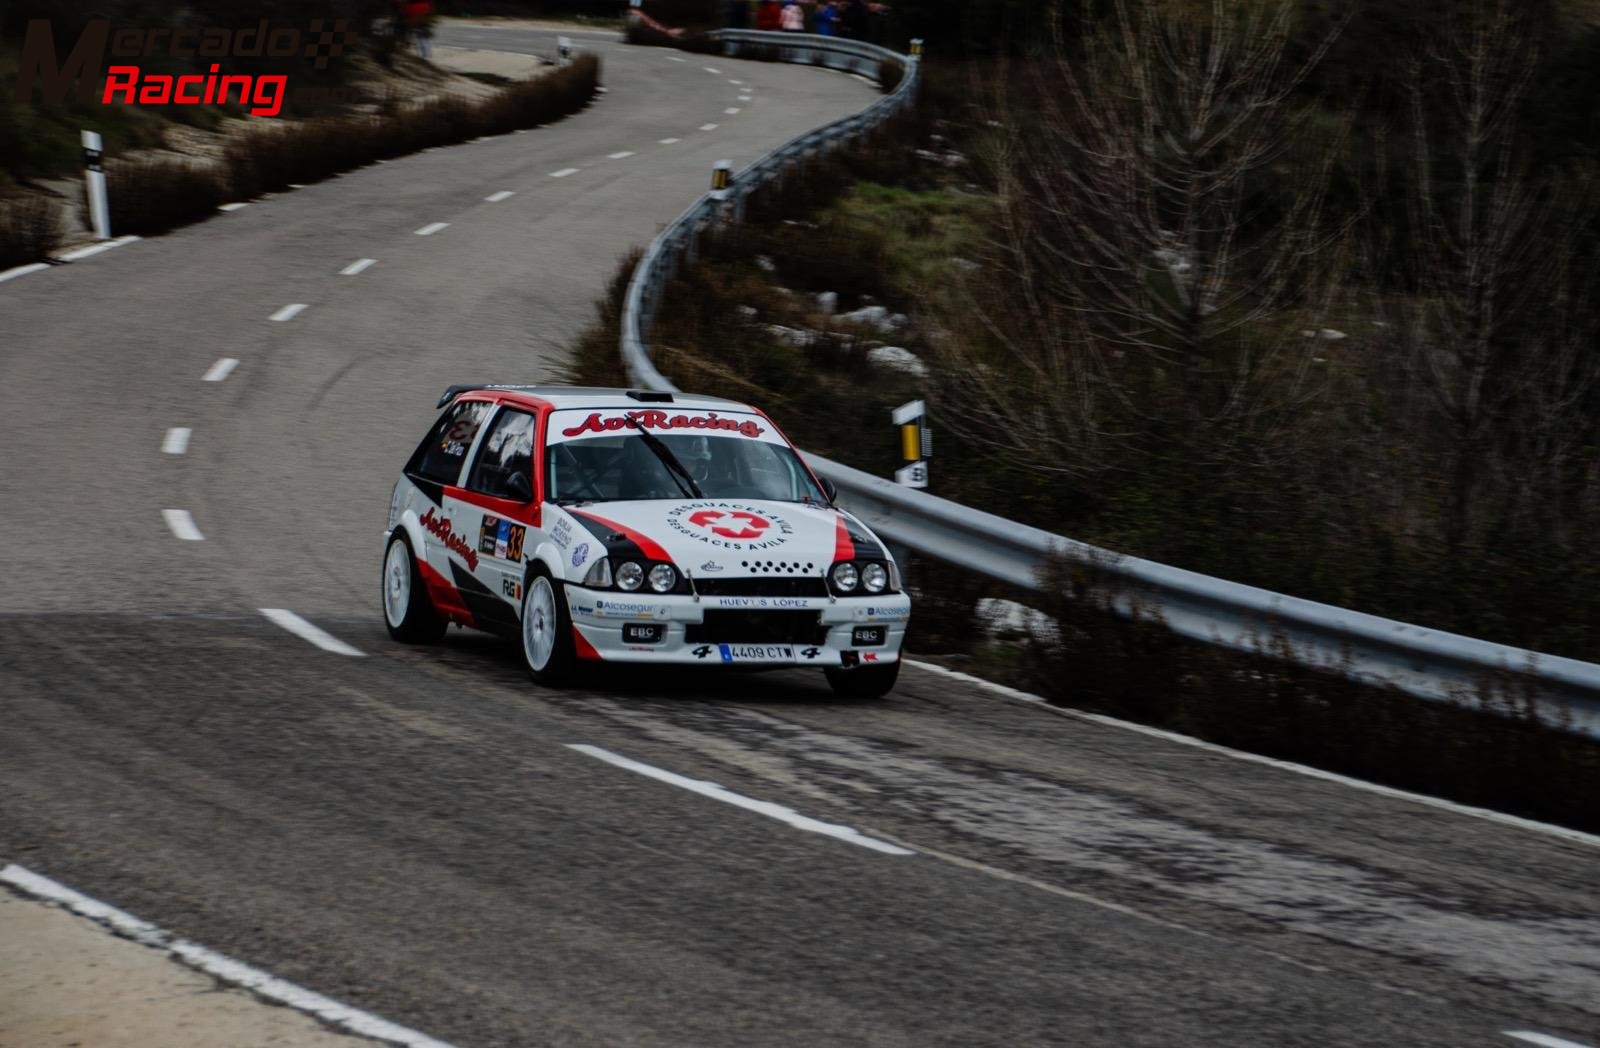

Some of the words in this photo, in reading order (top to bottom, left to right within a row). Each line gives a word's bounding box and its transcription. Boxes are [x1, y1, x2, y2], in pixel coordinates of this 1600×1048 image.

[667, 518, 742, 550] DESGUACES
[749, 537, 788, 551] AVILA
[508, 525, 525, 561] 33
[630, 627, 655, 639] EBC
[855, 629, 878, 641] EBC
[732, 645, 764, 658] 4409
